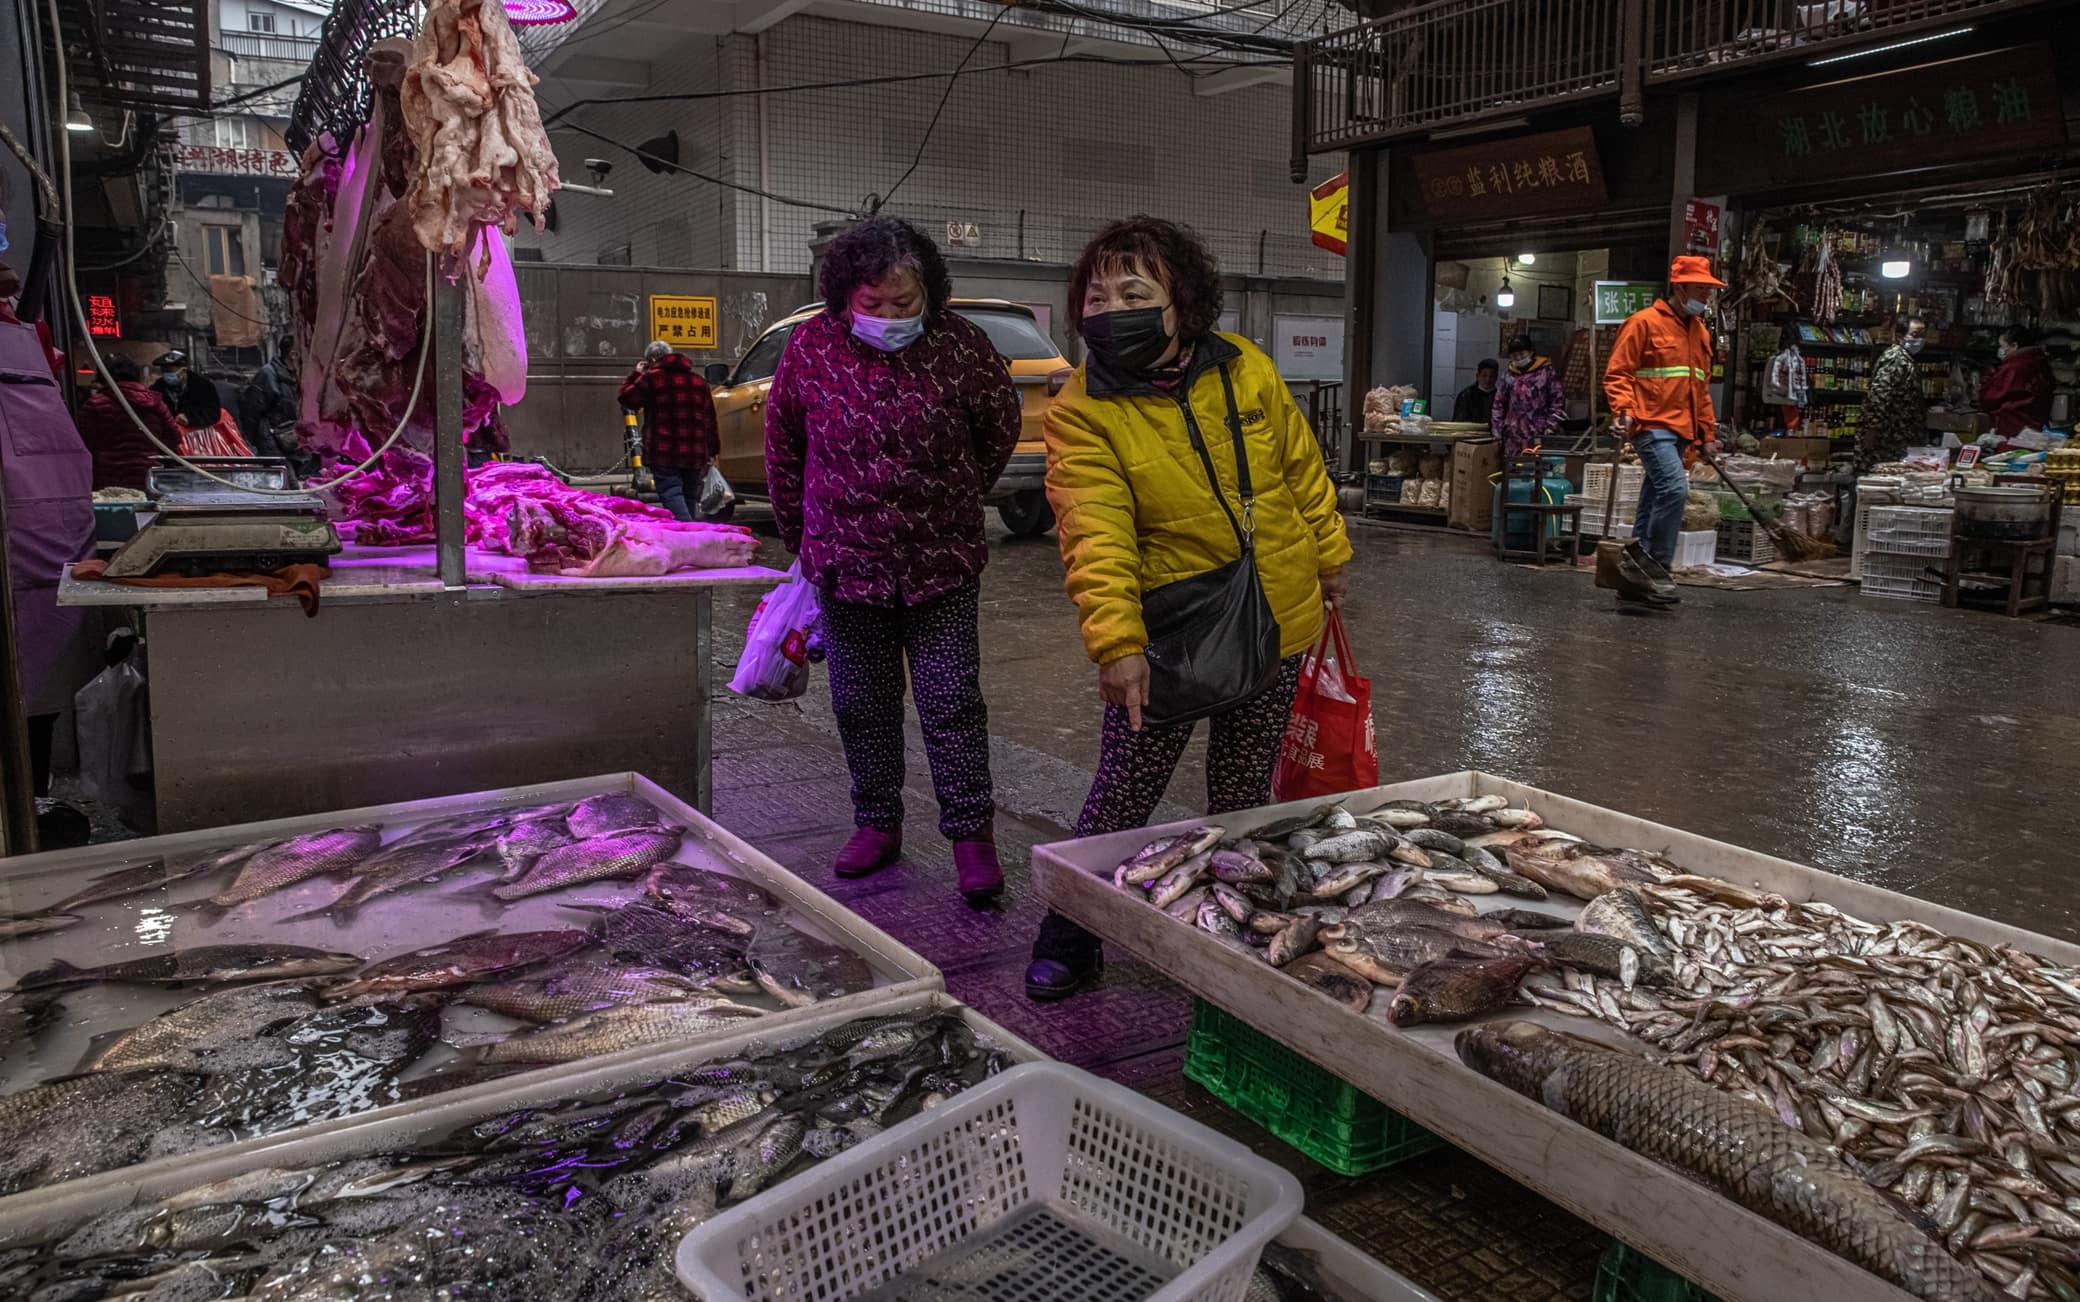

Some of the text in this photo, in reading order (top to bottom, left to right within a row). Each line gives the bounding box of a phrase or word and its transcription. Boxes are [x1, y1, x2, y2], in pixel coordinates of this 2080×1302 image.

[1778, 76, 2032, 156] 湖北放心粮油
[1466, 151, 1590, 197] 监利纯粮酒
[657, 307, 710, 319] 电力应急抢修通道
[659, 324, 710, 337] 严禁占用
